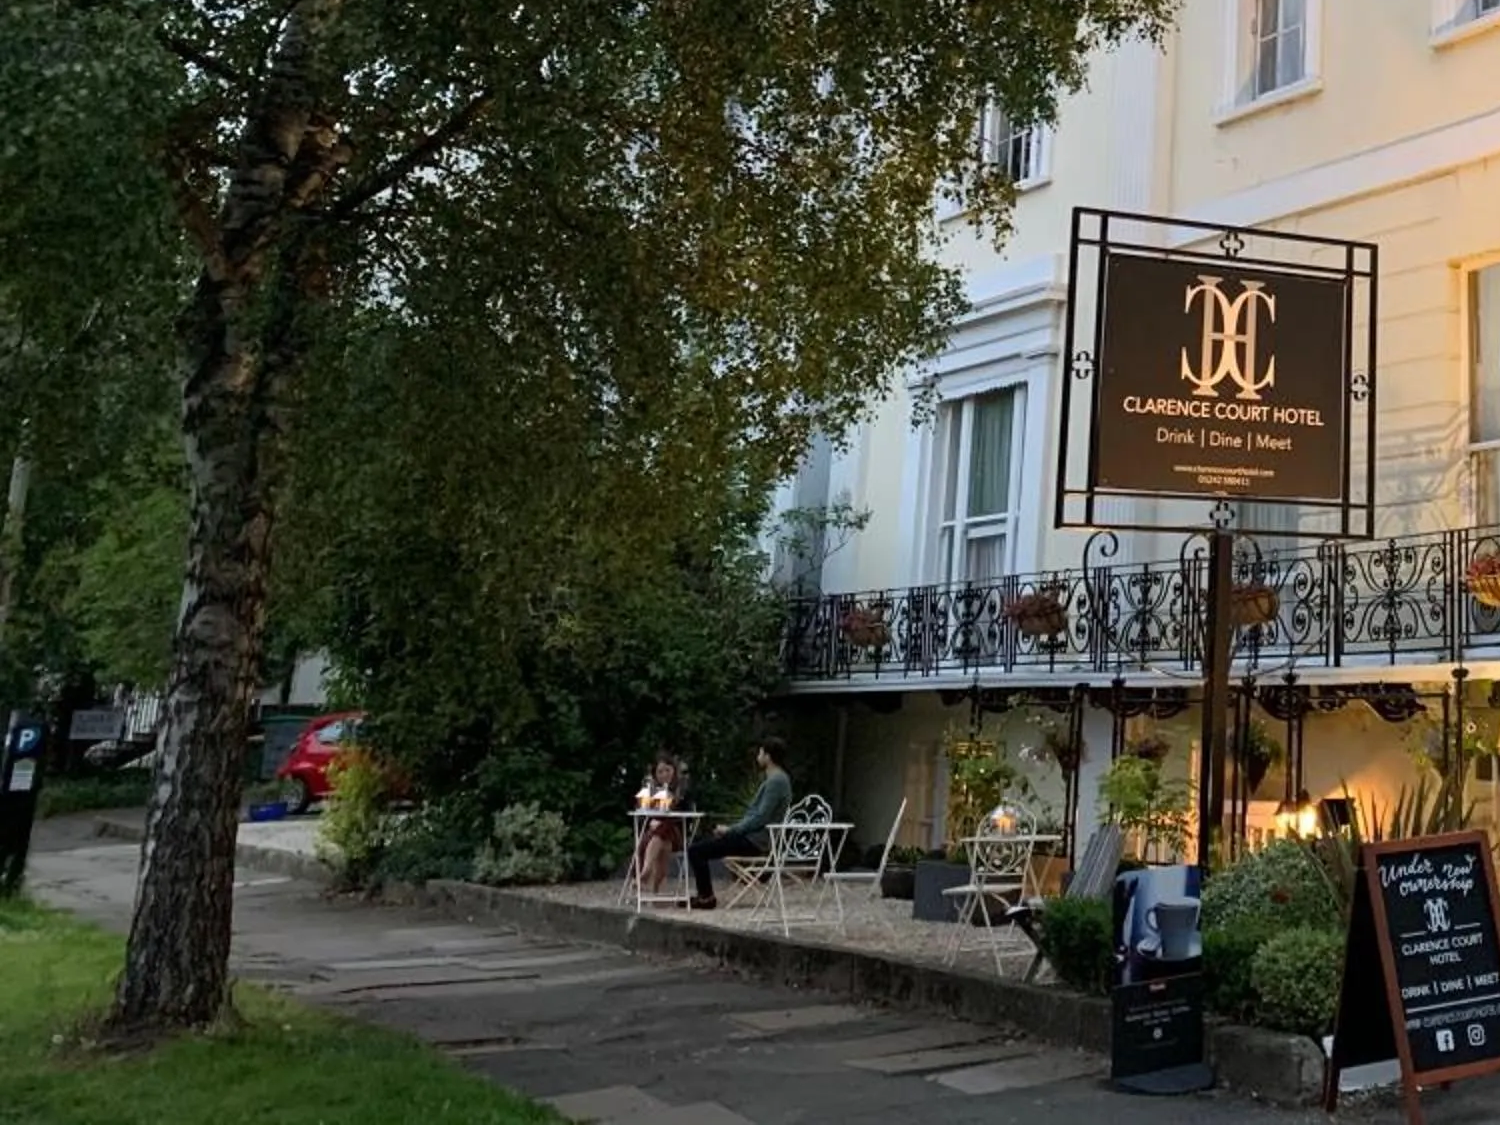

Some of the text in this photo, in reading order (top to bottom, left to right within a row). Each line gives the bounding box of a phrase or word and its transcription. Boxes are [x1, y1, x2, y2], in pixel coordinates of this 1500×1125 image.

[1123, 396, 1324, 426] CLARENCE COURT HOTEL
[1156, 427, 1292, 451] Drink Dine Meet
[18, 728, 35, 750] P
[1377, 853, 1477, 888] Under new
[1400, 875, 1474, 897] ownership
[1401, 932, 1483, 956] CLARENCE COURT
[1429, 951, 1462, 965] HOTEL
[1401, 971, 1499, 1000] DRINK DINE MEET
